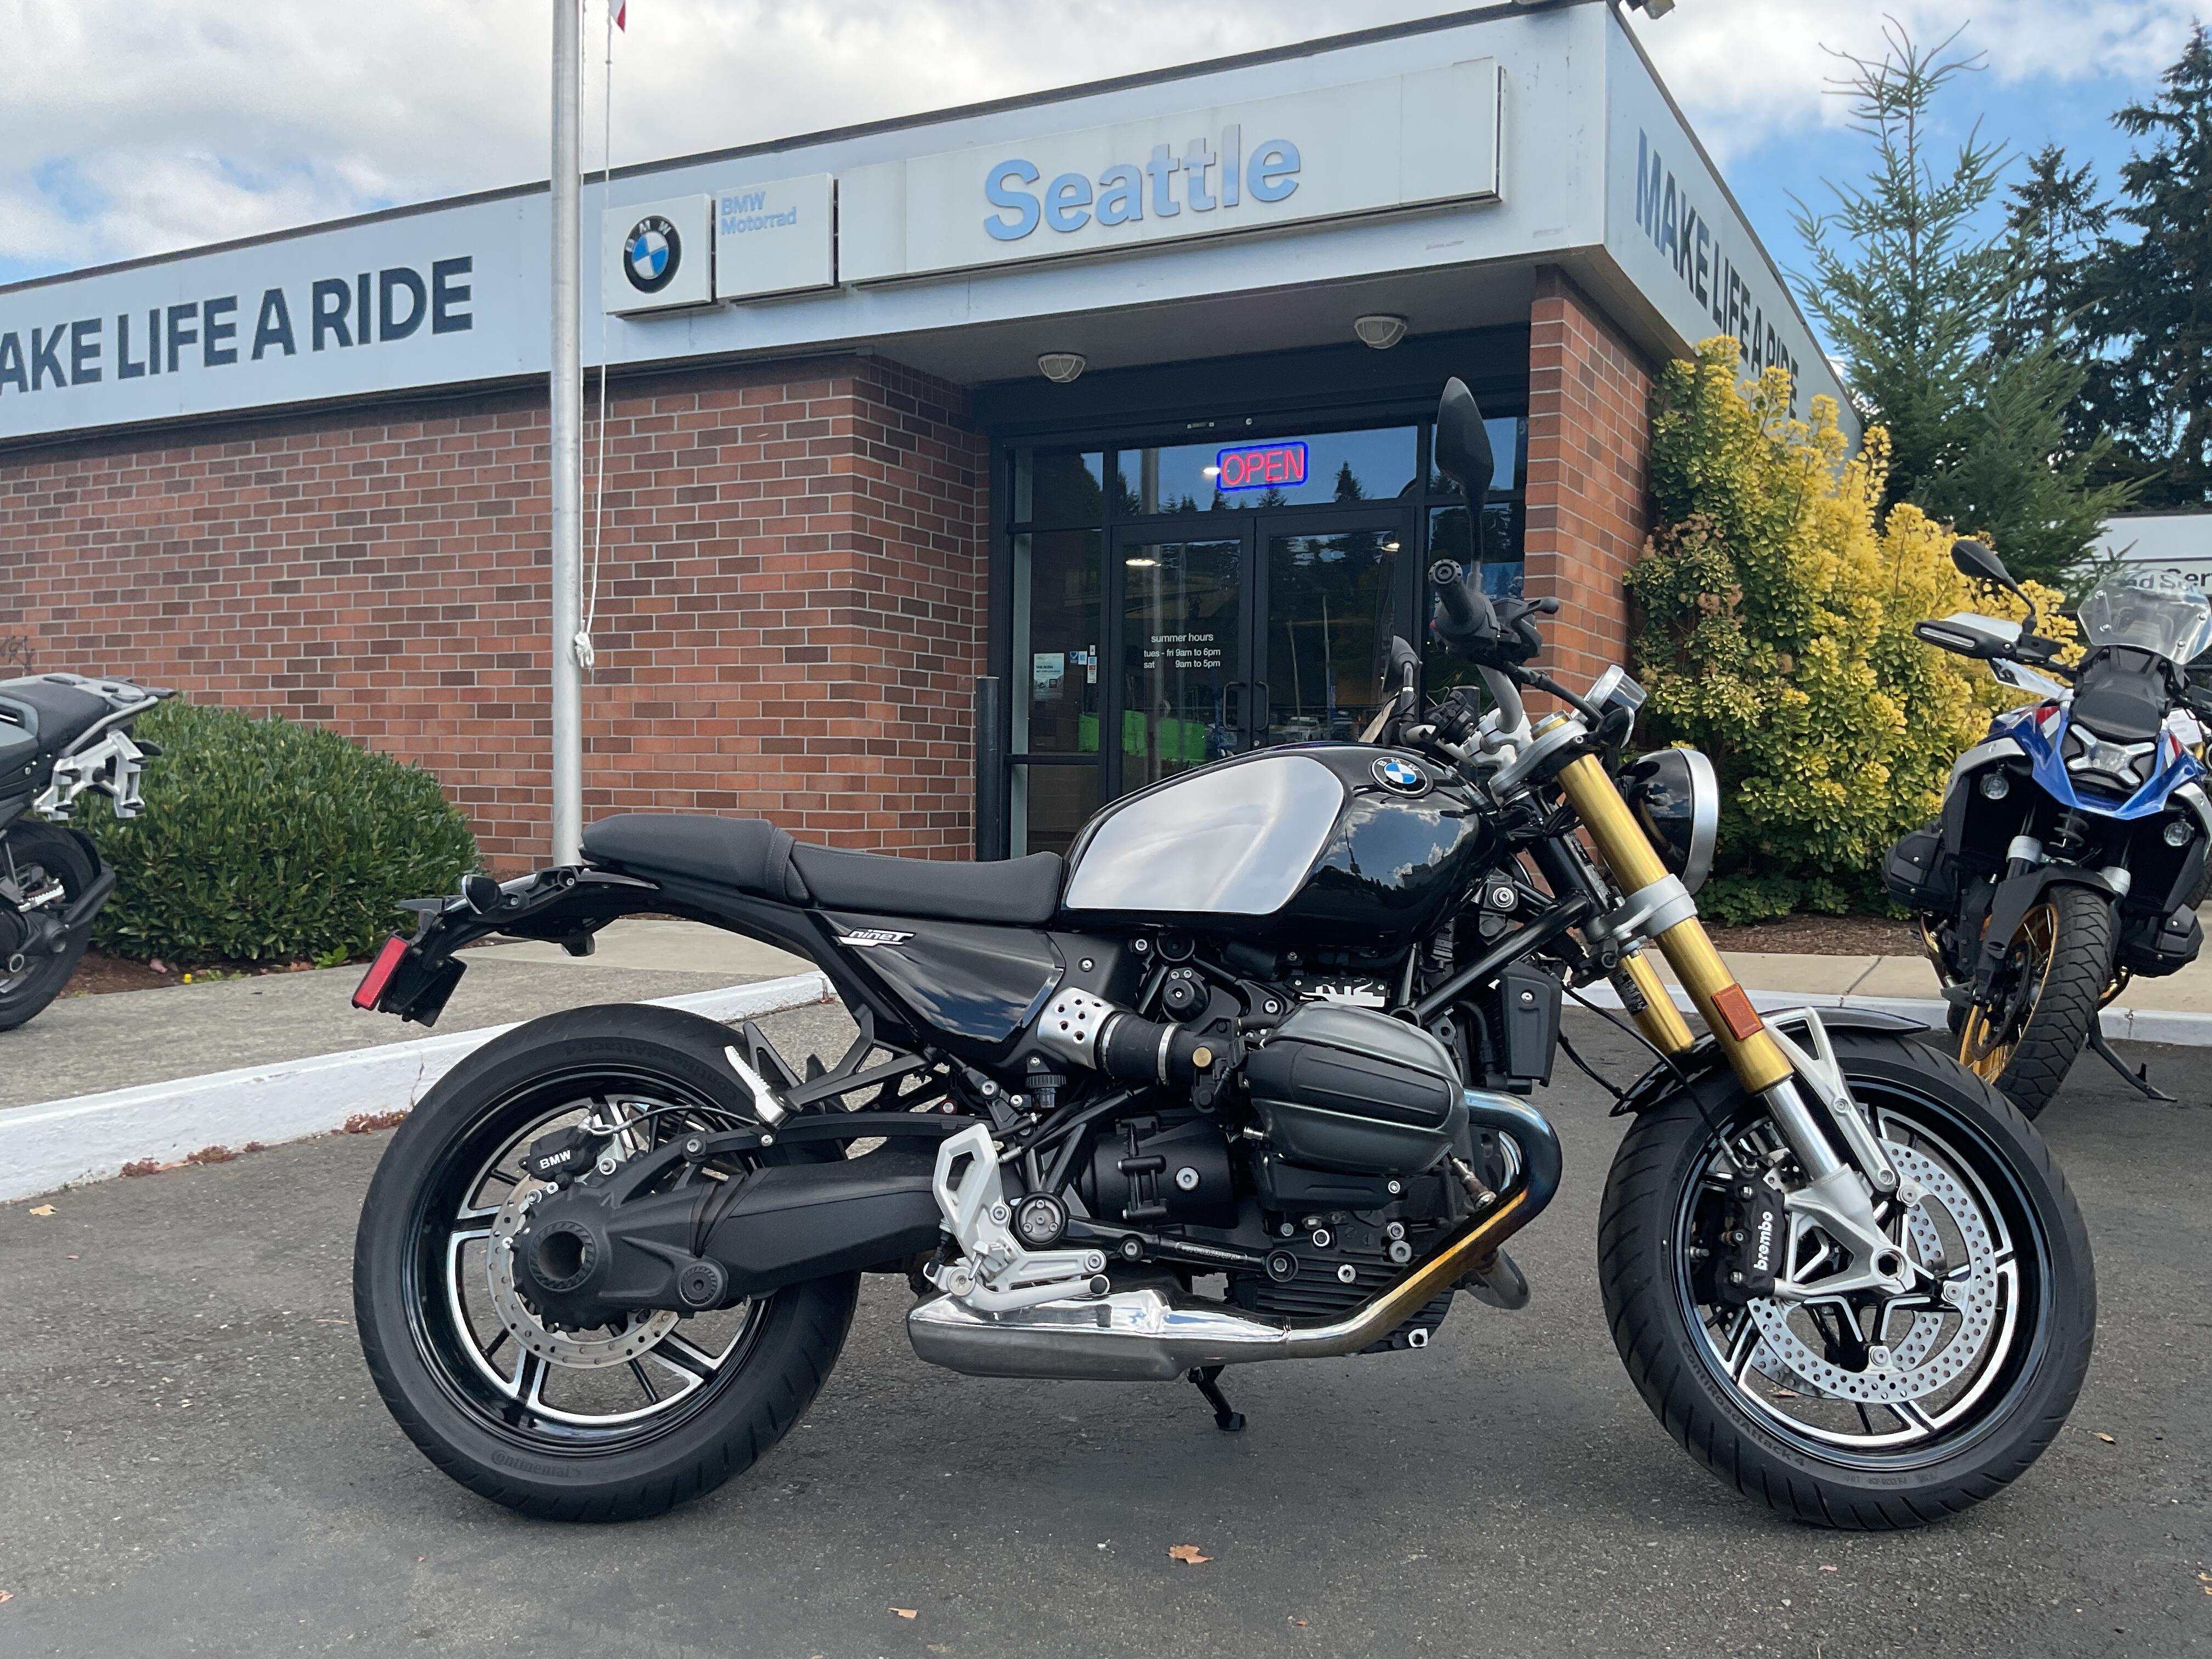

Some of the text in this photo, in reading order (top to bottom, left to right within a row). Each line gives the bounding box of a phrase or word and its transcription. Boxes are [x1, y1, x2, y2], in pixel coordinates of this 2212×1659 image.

[984, 124, 1301, 240] Seattle
[721, 191, 765, 216] BMW
[721, 206, 797, 235] Motorrad
[1635, 127, 1709, 311] MAKE
[1713, 240, 1751, 364] LIFE
[1751, 306, 1762, 379] A
[117, 295, 238, 379] LIFE
[251, 288, 297, 361] A
[312, 256, 473, 352] RIDE
[1222, 448, 1304, 485] OPEN
[1188, 633, 1214, 641] hours
[1144, 661, 1155, 669] sat
[1203, 659, 1221, 668] 5pm
[1203, 648, 1221, 657] 6pm
[539, 1149, 571, 1170] BMW
[1753, 1211, 1773, 1271] brembo
